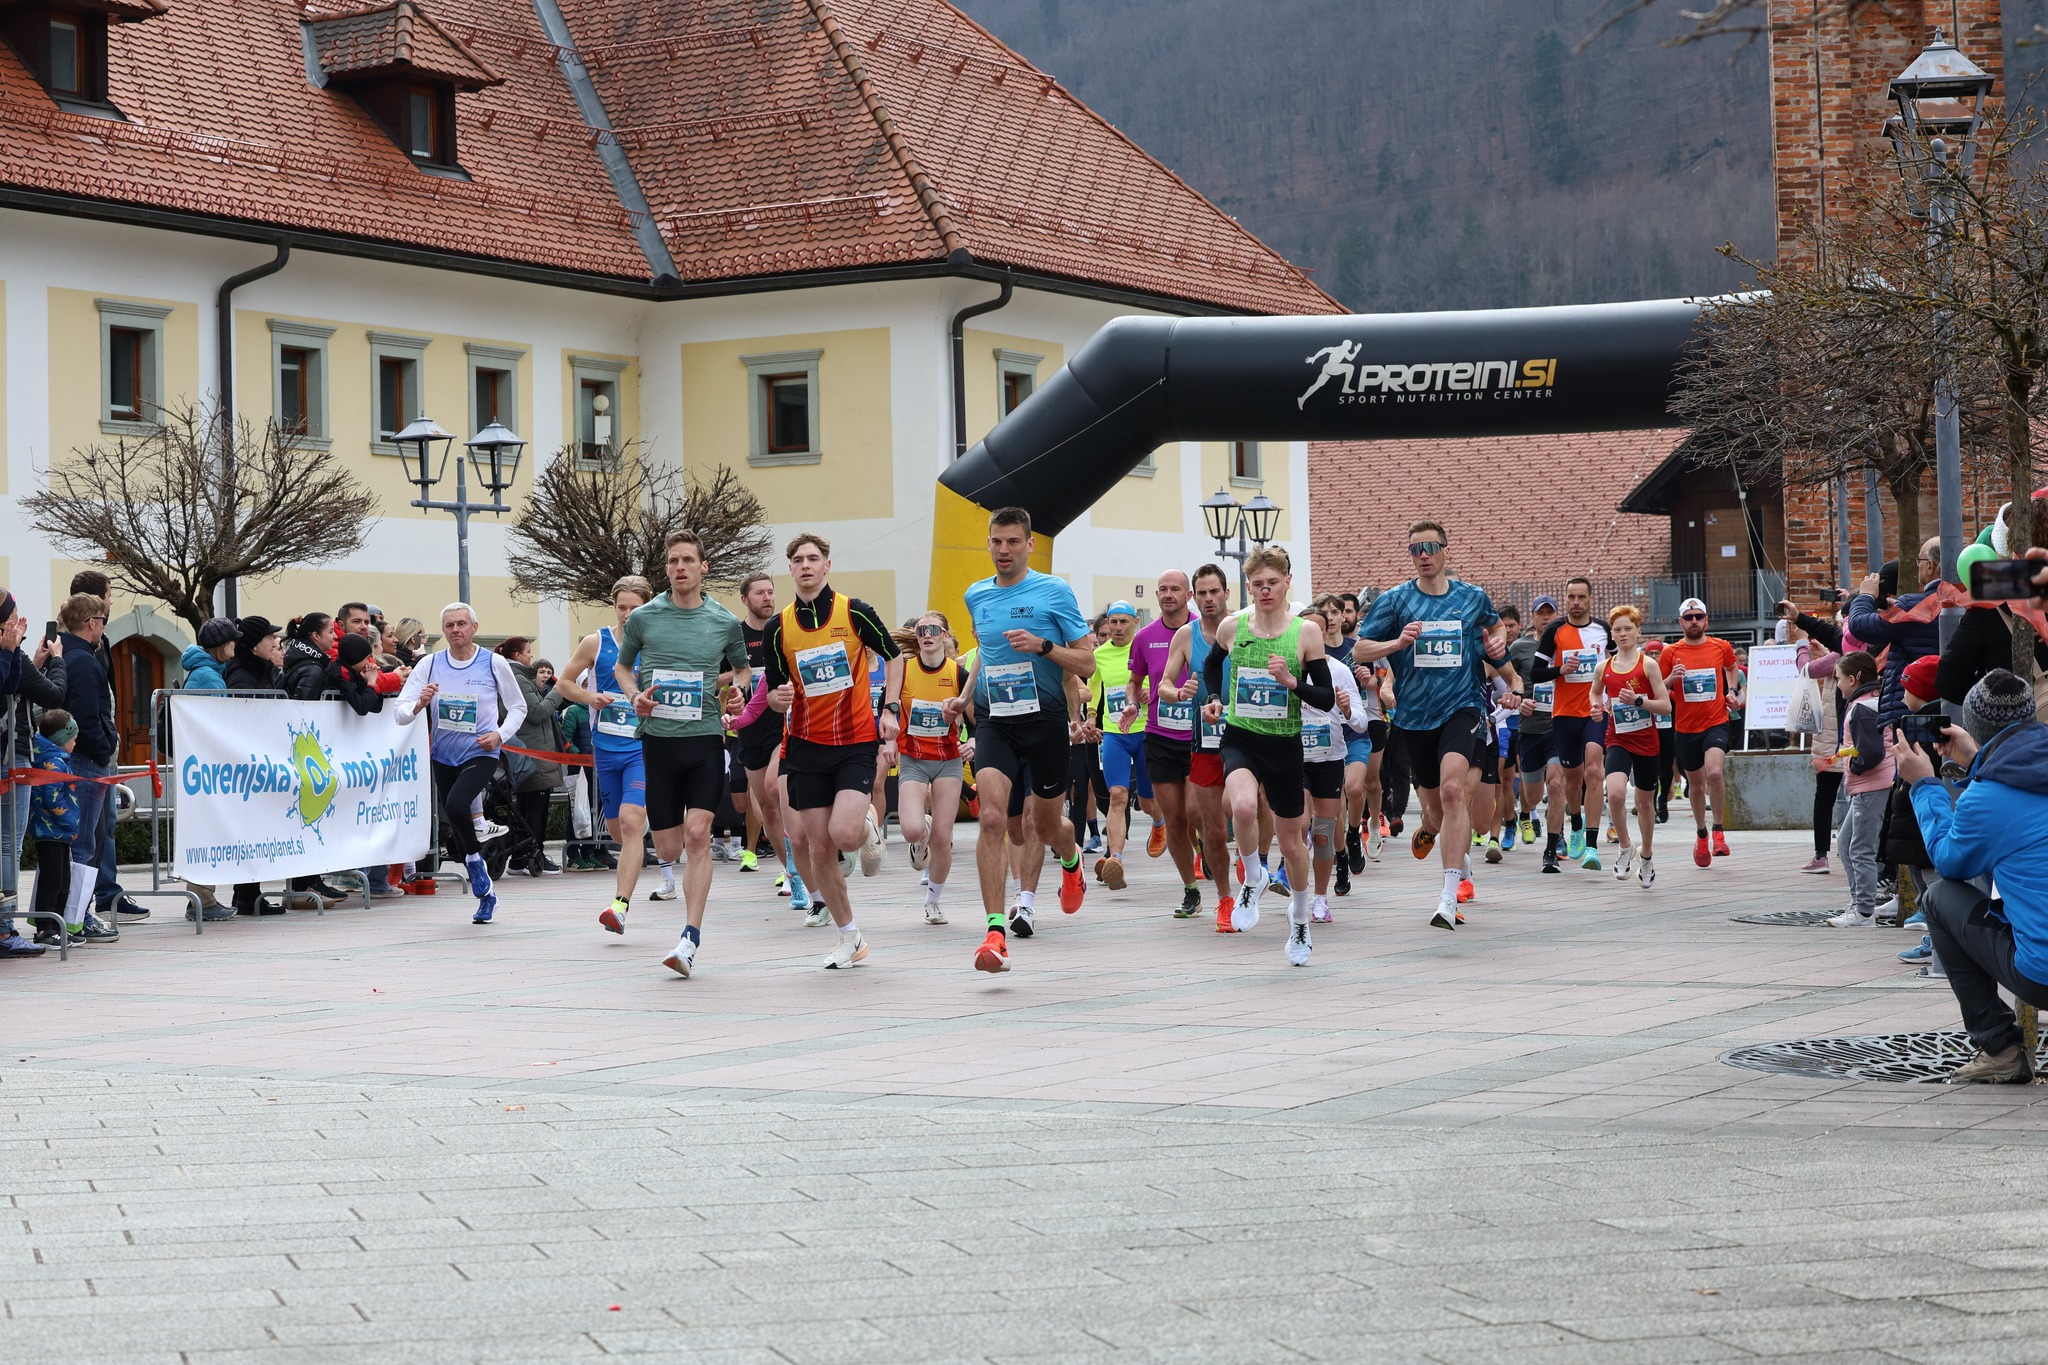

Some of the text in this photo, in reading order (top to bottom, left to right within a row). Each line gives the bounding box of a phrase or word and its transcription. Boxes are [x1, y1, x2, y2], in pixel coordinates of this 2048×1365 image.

[1358, 358, 1557, 393] PROTEINI.SI
[1338, 389, 1553, 405] SPORT NUTRITION CENTER
[1010, 606, 1034, 615] KOV
[294, 641, 323, 659] Jeans
[1425, 640, 1453, 654] 146
[1758, 659, 1780, 667] START
[815, 665, 836, 681] 48
[1005, 686, 1014, 701] 1
[1696, 682, 1704, 693] 5
[662, 690, 693, 706] 120
[1251, 690, 1270, 704] 41
[1540, 693, 1552, 703] 11
[1113, 701, 1127, 712] 14
[1167, 706, 1189, 718] 141
[1766, 706, 1787, 714] START
[449, 709, 465, 721] 67
[616, 712, 627, 724] 3
[1624, 711, 1640, 722] 34
[922, 716, 939, 727] 55
[1210, 723, 1227, 736] 10
[1301, 735, 1319, 746] 65
[182, 754, 292, 802] Gorenjska
[340, 751, 378, 794] moj
[403, 794, 418, 825] ga!
[185, 834, 306, 868] www.gorenjska-mojplanet.si
